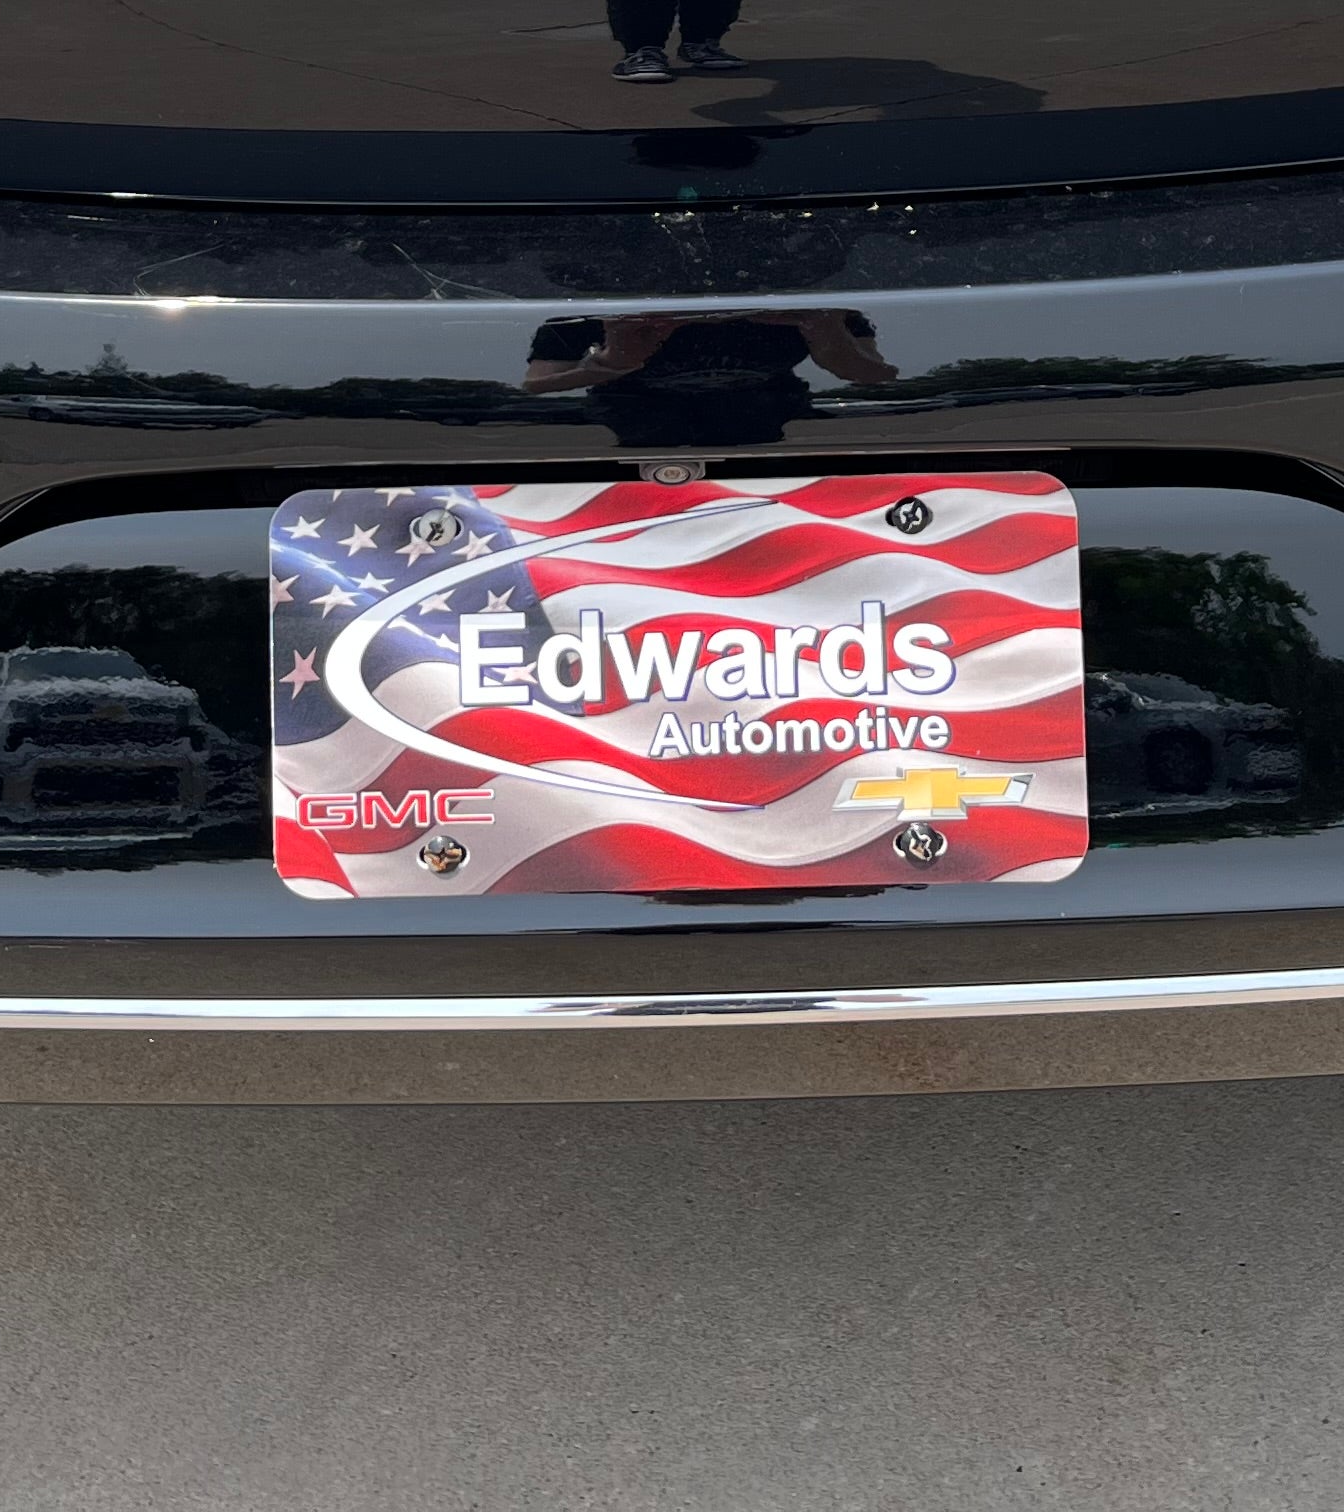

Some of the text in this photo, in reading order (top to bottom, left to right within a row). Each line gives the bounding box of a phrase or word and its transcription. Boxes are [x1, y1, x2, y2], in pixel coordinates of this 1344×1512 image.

[459, 600, 957, 708] Edwards
[648, 706, 951, 760] Automotive
[296, 789, 497, 830] GMC
